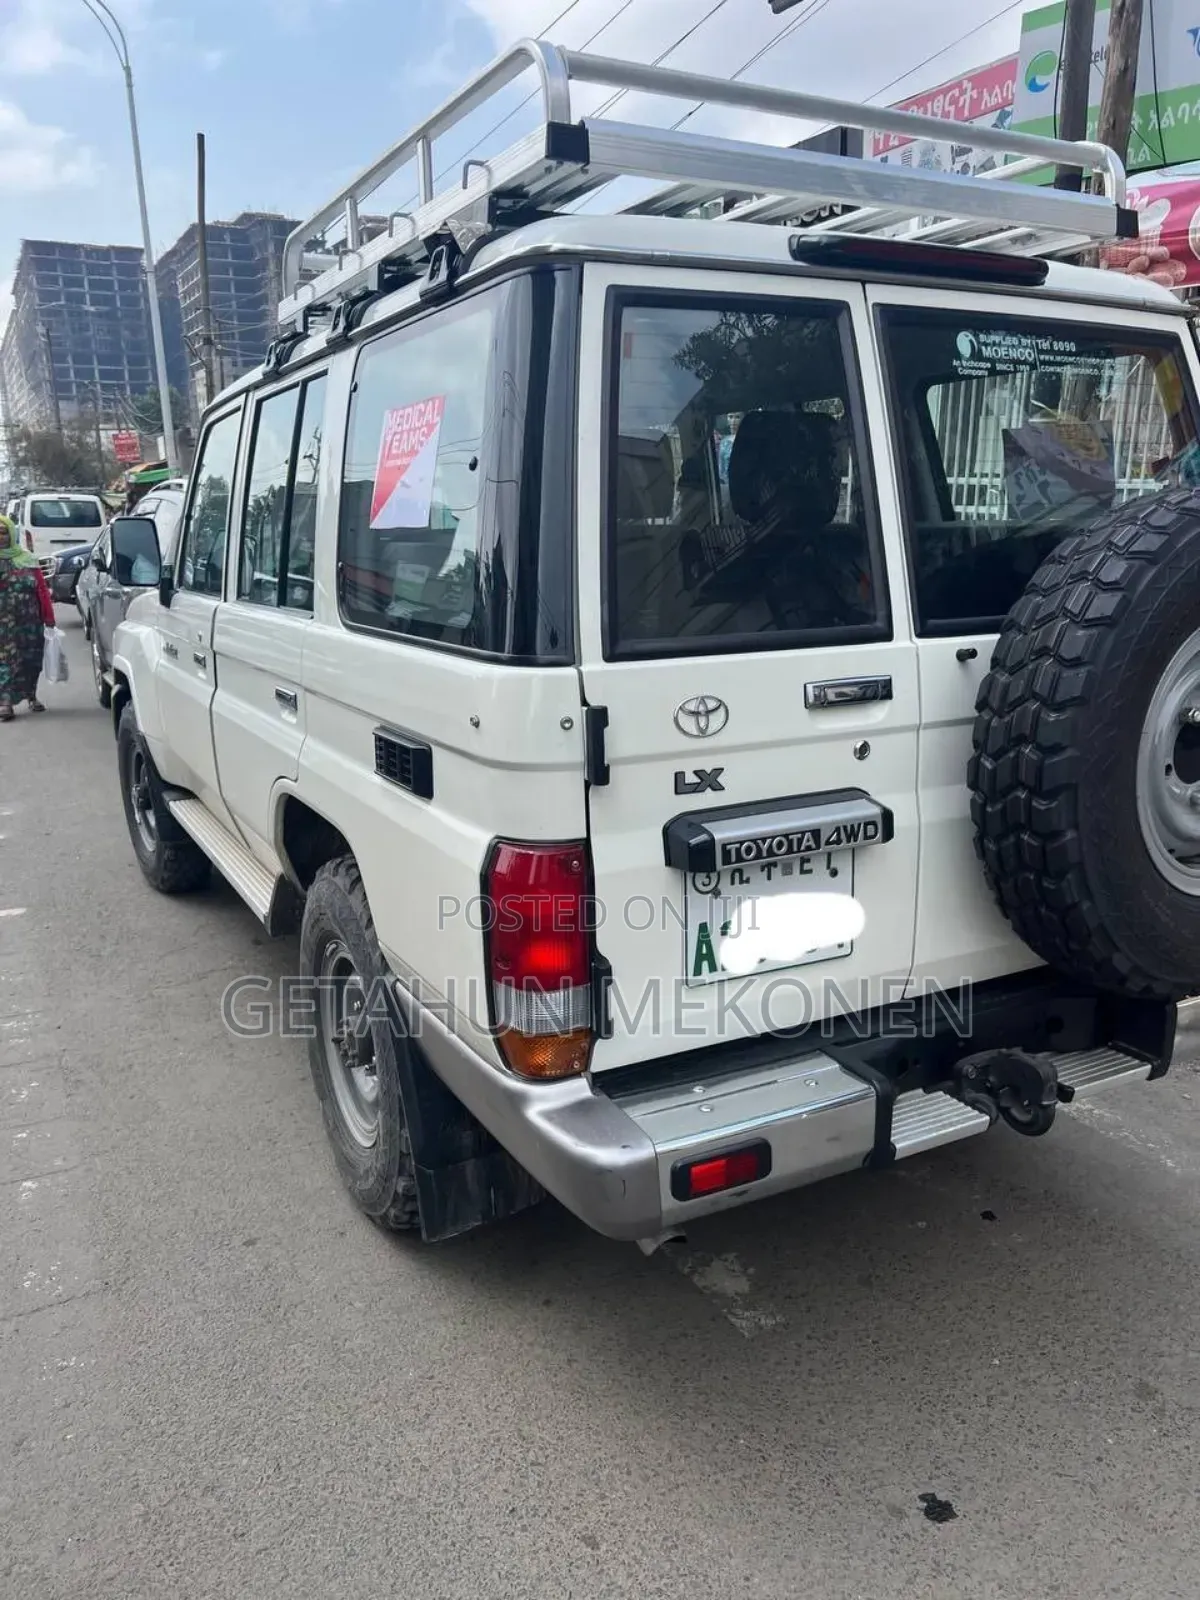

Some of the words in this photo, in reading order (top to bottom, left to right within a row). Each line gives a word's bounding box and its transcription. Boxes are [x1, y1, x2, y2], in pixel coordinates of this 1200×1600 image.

[980, 345, 1034, 361] MOENCO
[386, 398, 440, 433] MEDICAL
[384, 426, 428, 460] TEAMS
[674, 767, 725, 795] LX
[726, 832, 816, 864] TOYOTA
[824, 820, 879, 847] 4WD
